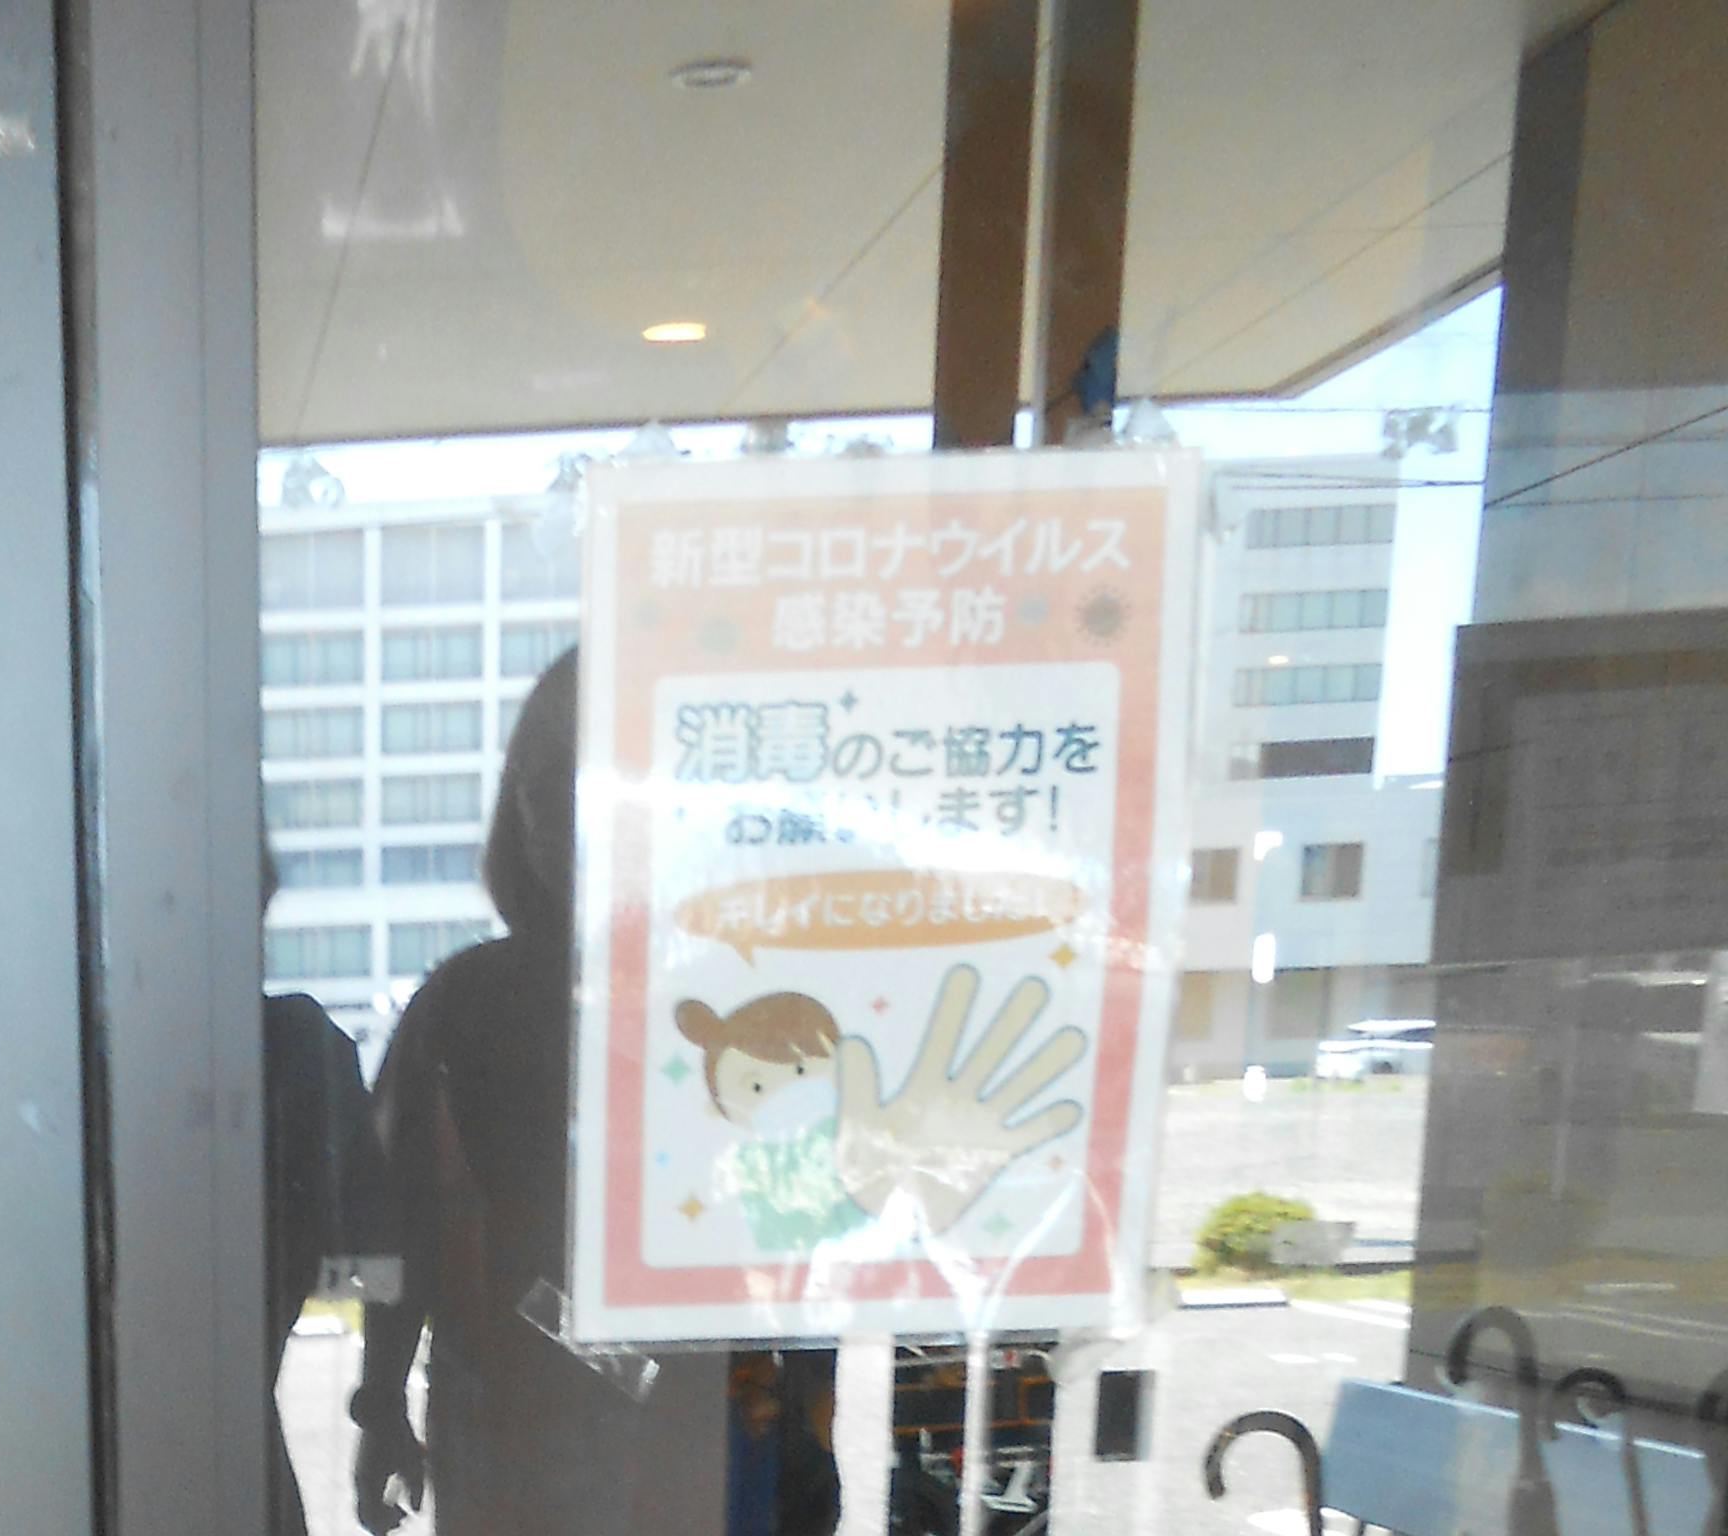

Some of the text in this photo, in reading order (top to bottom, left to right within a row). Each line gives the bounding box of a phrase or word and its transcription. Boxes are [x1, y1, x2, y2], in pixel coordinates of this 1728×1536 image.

[648, 518, 1132, 590] 新型コロナウイルス
[772, 588, 1006, 652] 感染予防
[675, 700, 1102, 783] 消毒のご協力を
